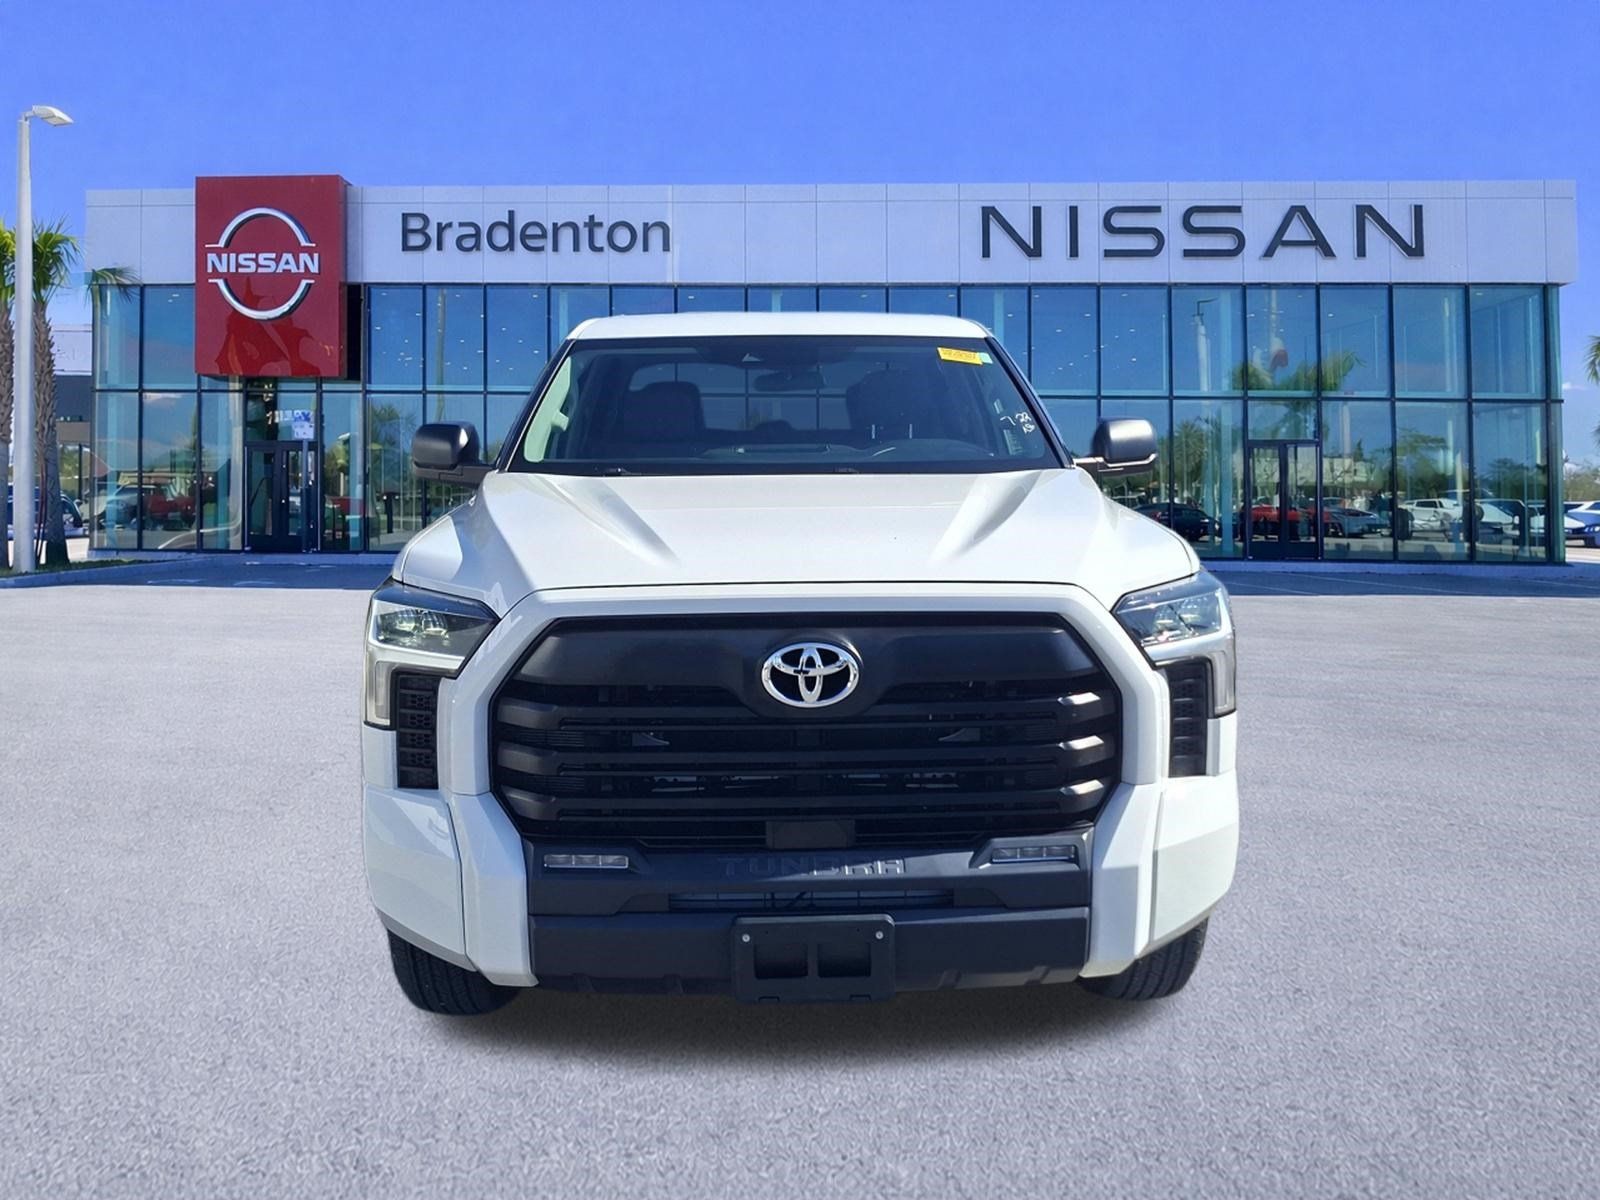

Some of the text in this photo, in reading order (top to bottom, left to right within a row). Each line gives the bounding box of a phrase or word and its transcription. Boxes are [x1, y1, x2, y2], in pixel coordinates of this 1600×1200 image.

[401, 210, 671, 252] Bradenton
[981, 204, 1426, 258] NISSAN
[206, 252, 319, 274] NISSAN
[717, 857, 906, 877] TUNDRA
